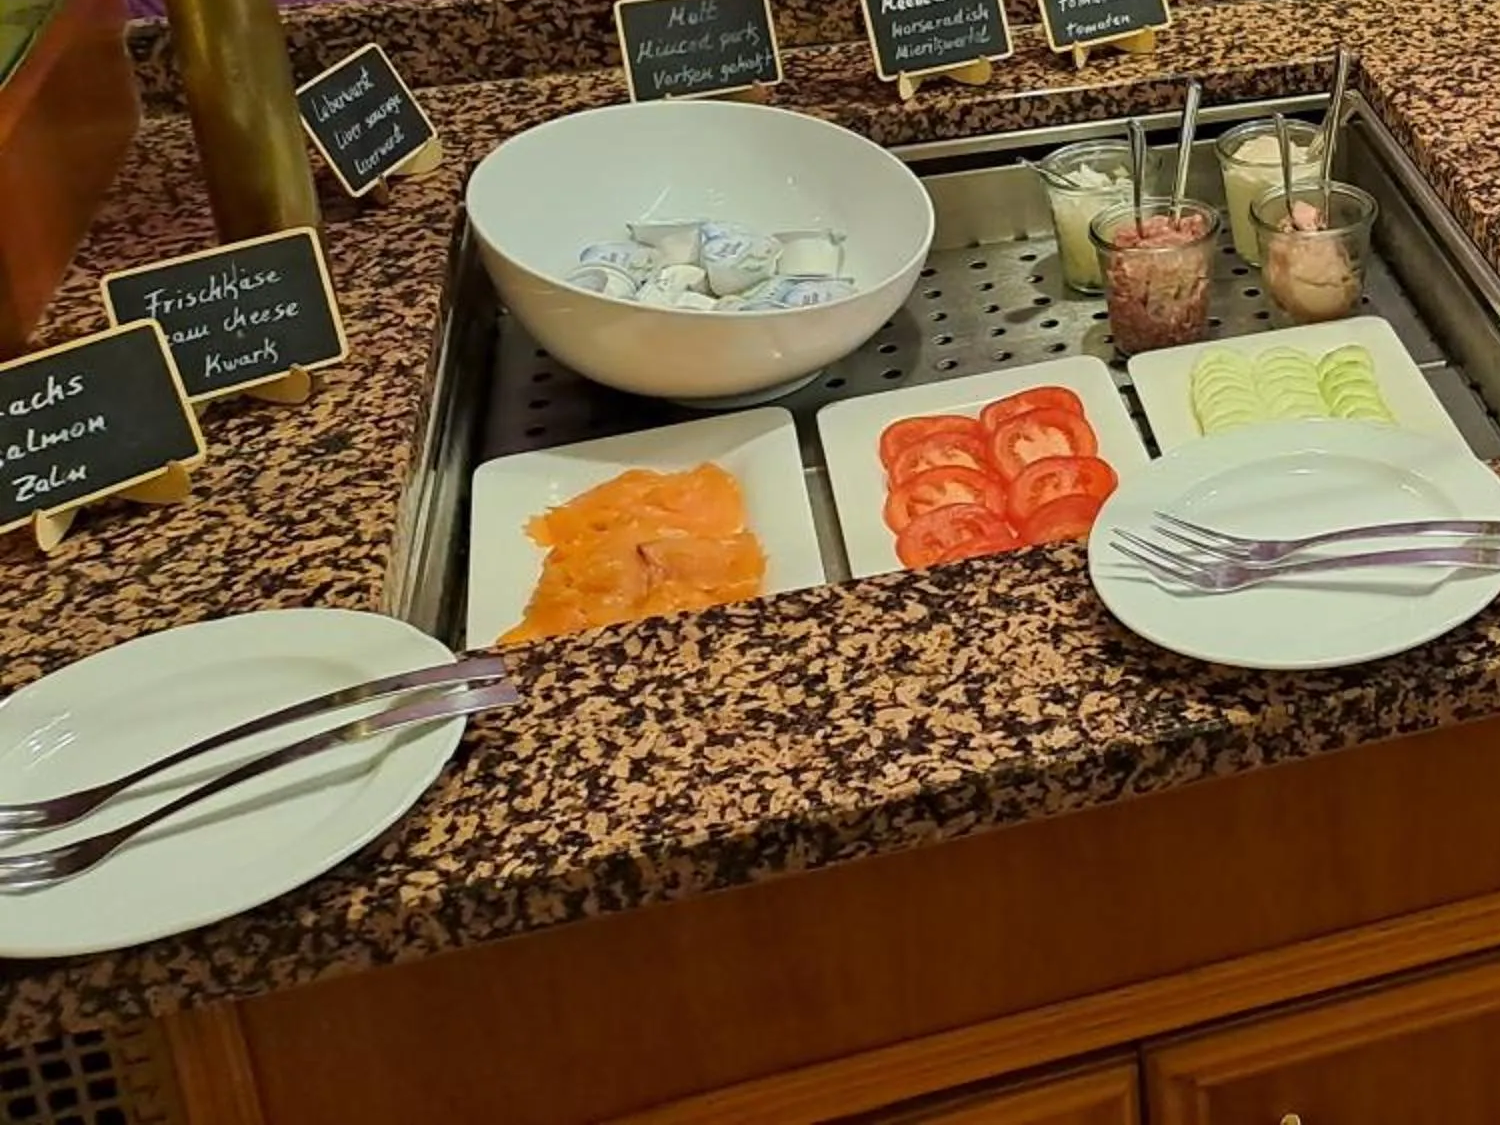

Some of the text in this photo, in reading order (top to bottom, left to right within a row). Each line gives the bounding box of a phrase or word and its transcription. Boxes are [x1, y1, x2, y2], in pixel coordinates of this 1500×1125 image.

[224, 302, 299, 331] cheese
[206, 337, 279, 377] Kwark
[0, 375, 84, 415] achs
[0, 415, 107, 468] almon
